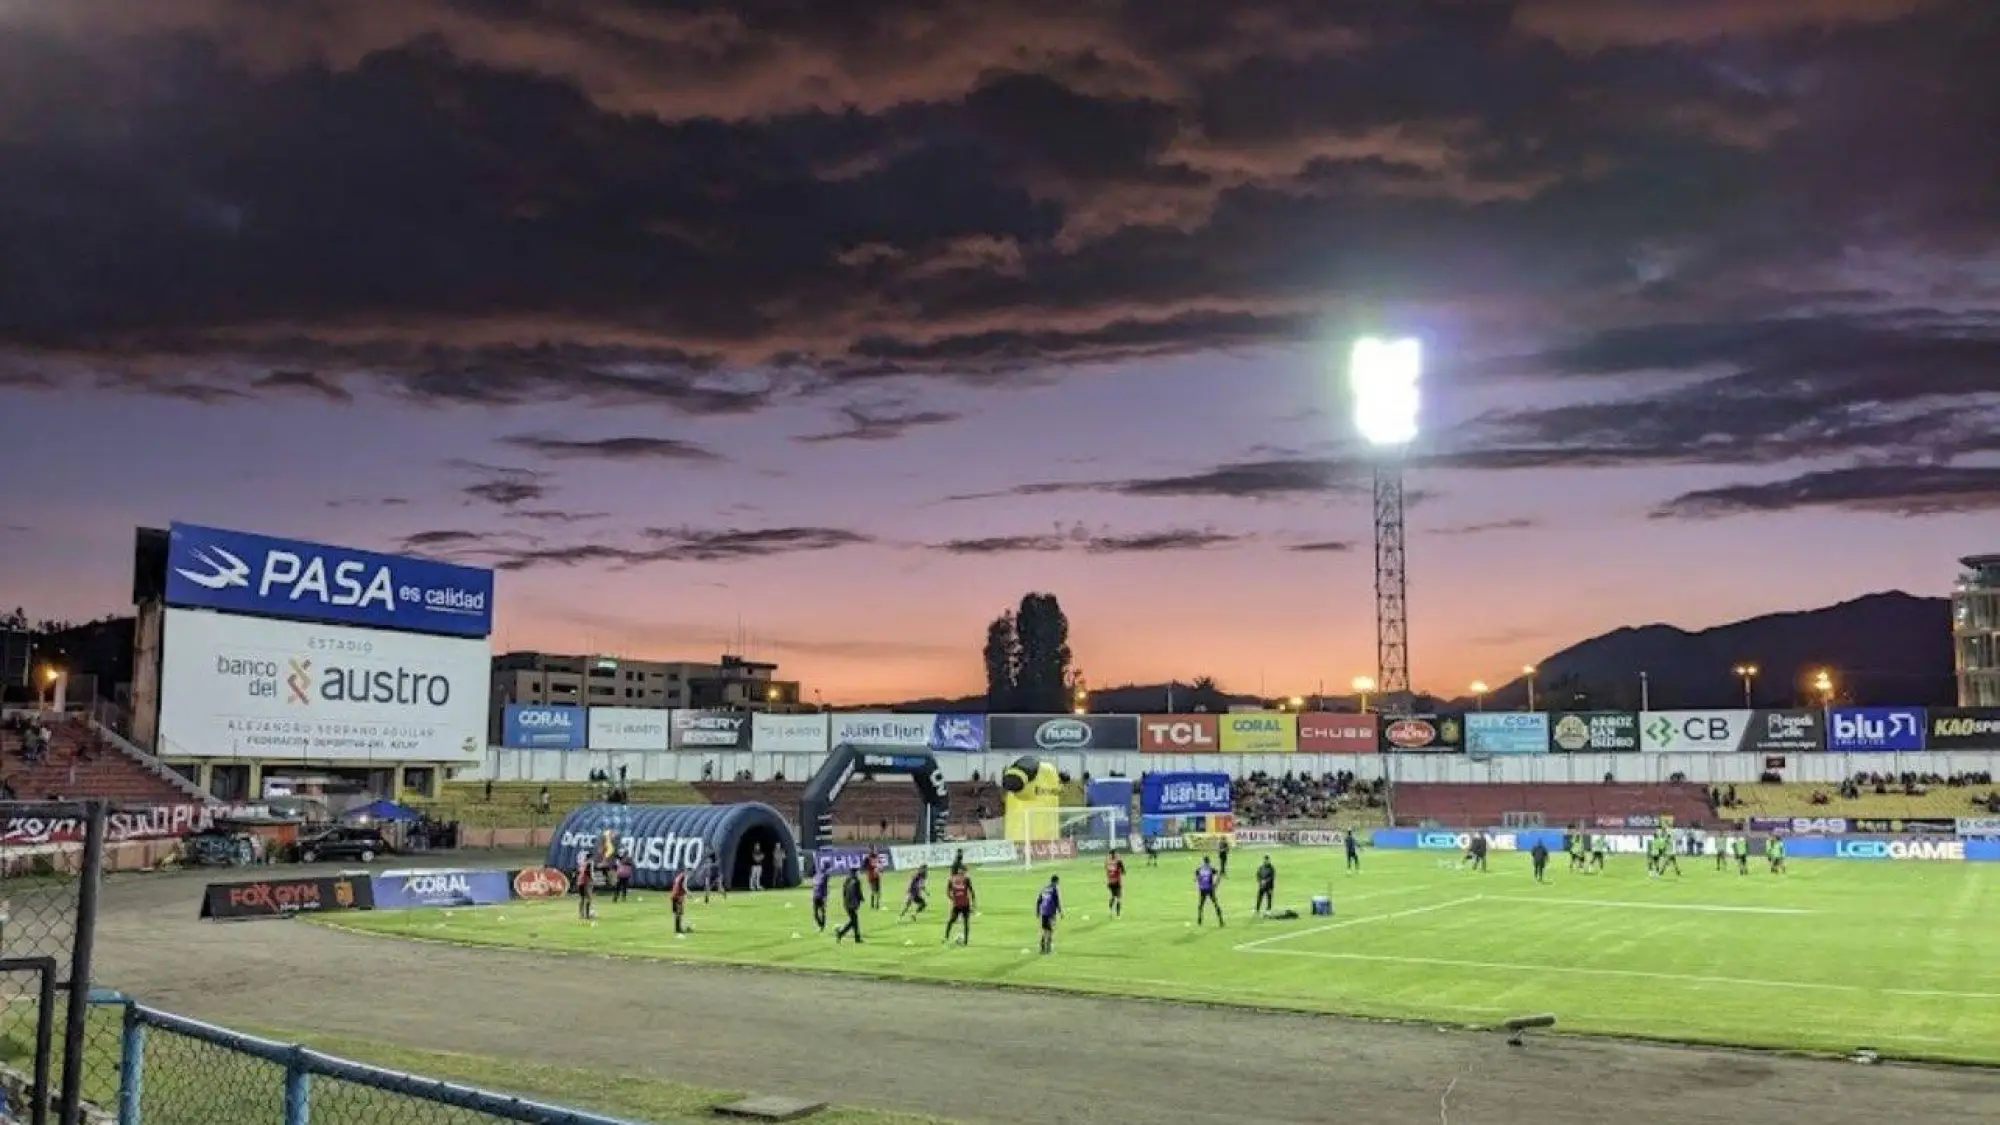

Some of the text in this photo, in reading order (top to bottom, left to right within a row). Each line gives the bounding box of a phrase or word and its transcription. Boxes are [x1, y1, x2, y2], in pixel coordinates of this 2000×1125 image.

[258, 550, 484, 611] PASA es calidad
[307, 637, 373, 653] ESTADIO
[217, 655, 277, 677] banco
[249, 678, 277, 698] del
[320, 666, 449, 706] austro
[518, 710, 573, 726] CORAL
[676, 716, 744, 729] CHERY
[1232, 719, 1283, 732] CORAL
[1833, 713, 1884, 738] blu
[228, 720, 435, 738] ALEJANDRO SERRANO AGUILAR
[840, 723, 880, 738] Juan
[1148, 722, 1213, 745] TCL
[1300, 727, 1373, 739] CHUBB
[1684, 717, 1730, 741] CB
[1161, 781, 1194, 803] Juan
[275, 884, 320, 902] GYM
[412, 876, 471, 894] CORAL
